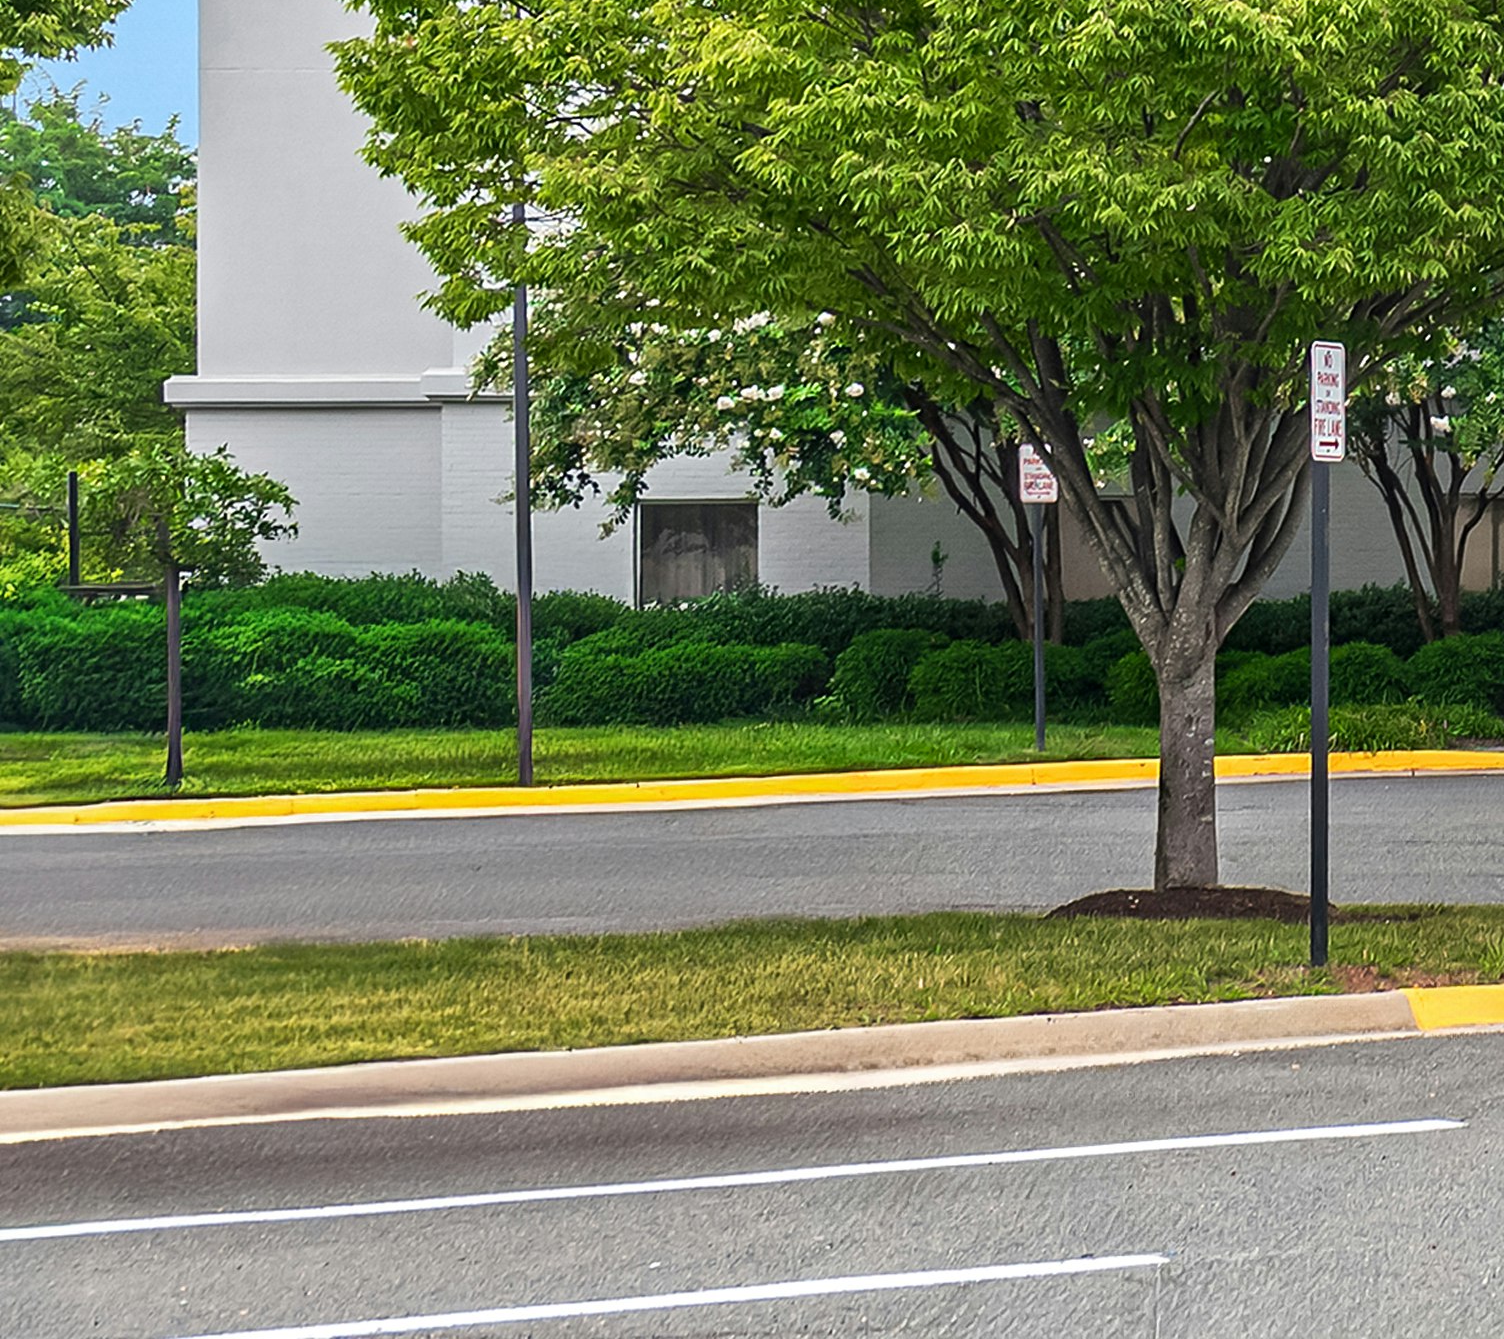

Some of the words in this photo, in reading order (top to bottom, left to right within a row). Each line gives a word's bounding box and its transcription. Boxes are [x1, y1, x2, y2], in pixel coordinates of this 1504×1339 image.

[1317, 372, 1339, 387] PARKING
[1316, 400, 1341, 415] STANDING
[1315, 418, 1326, 436] FIRE
[1327, 420, 1342, 437] LANE
